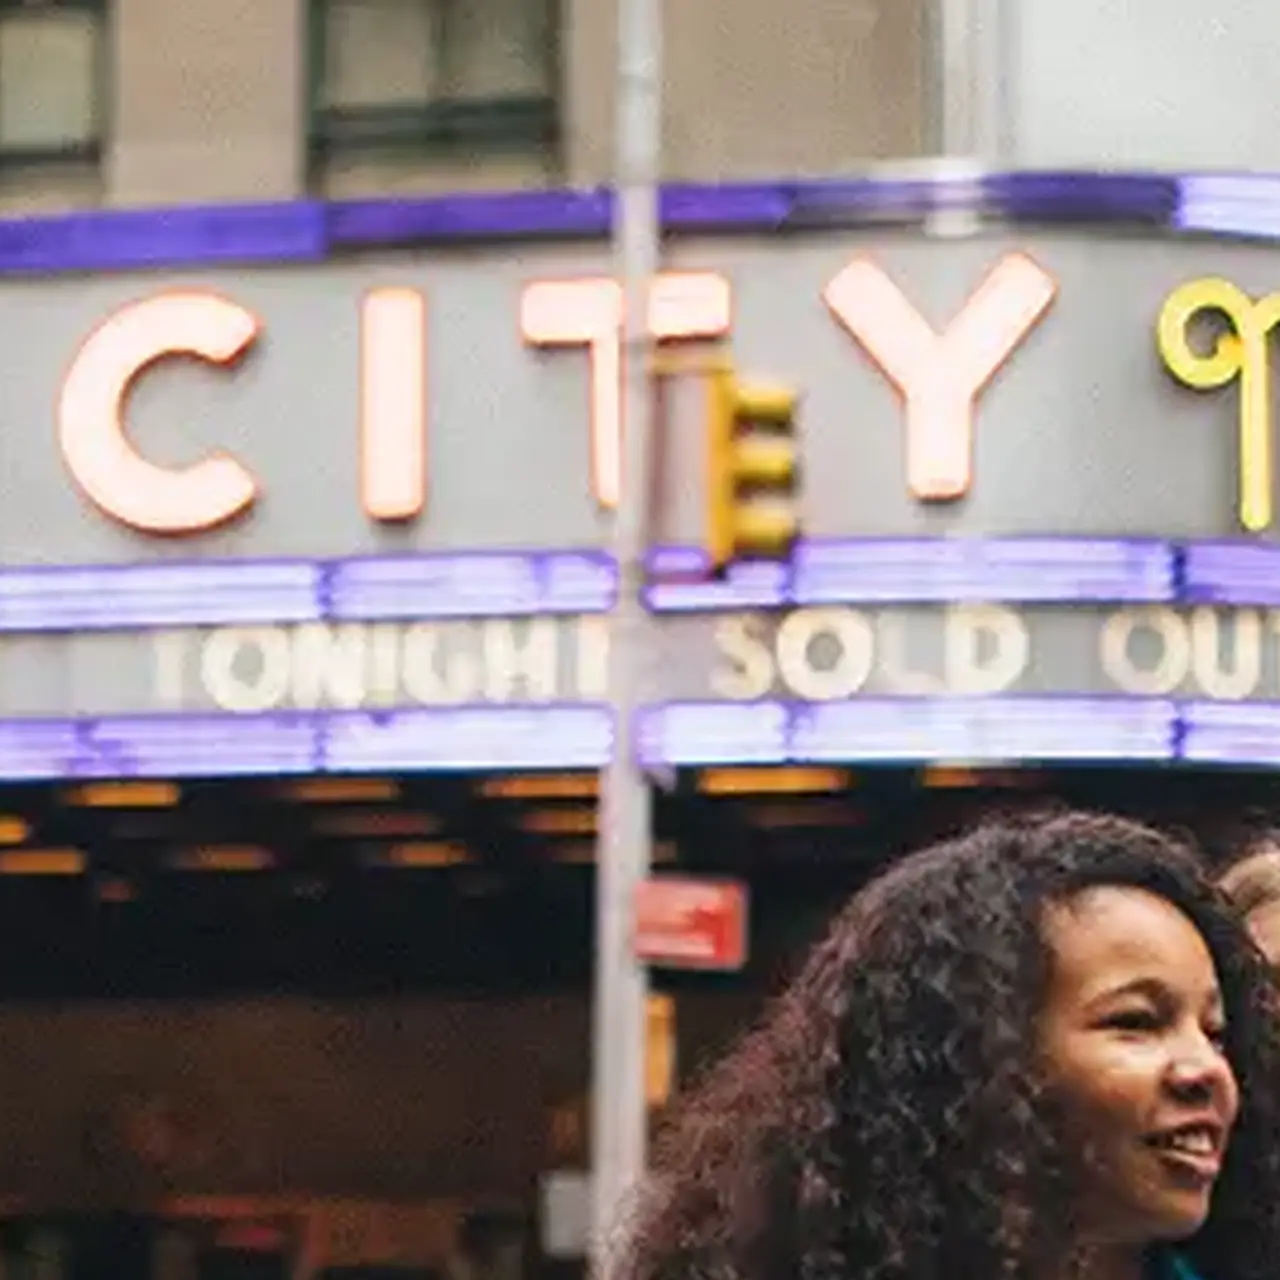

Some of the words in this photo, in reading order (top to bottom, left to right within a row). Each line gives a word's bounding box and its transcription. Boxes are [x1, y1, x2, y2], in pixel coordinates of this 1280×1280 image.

[58, 250, 1059, 537] CITY
[154, 617, 612, 714] TONIGHT
[712, 603, 1030, 702] SOLD
